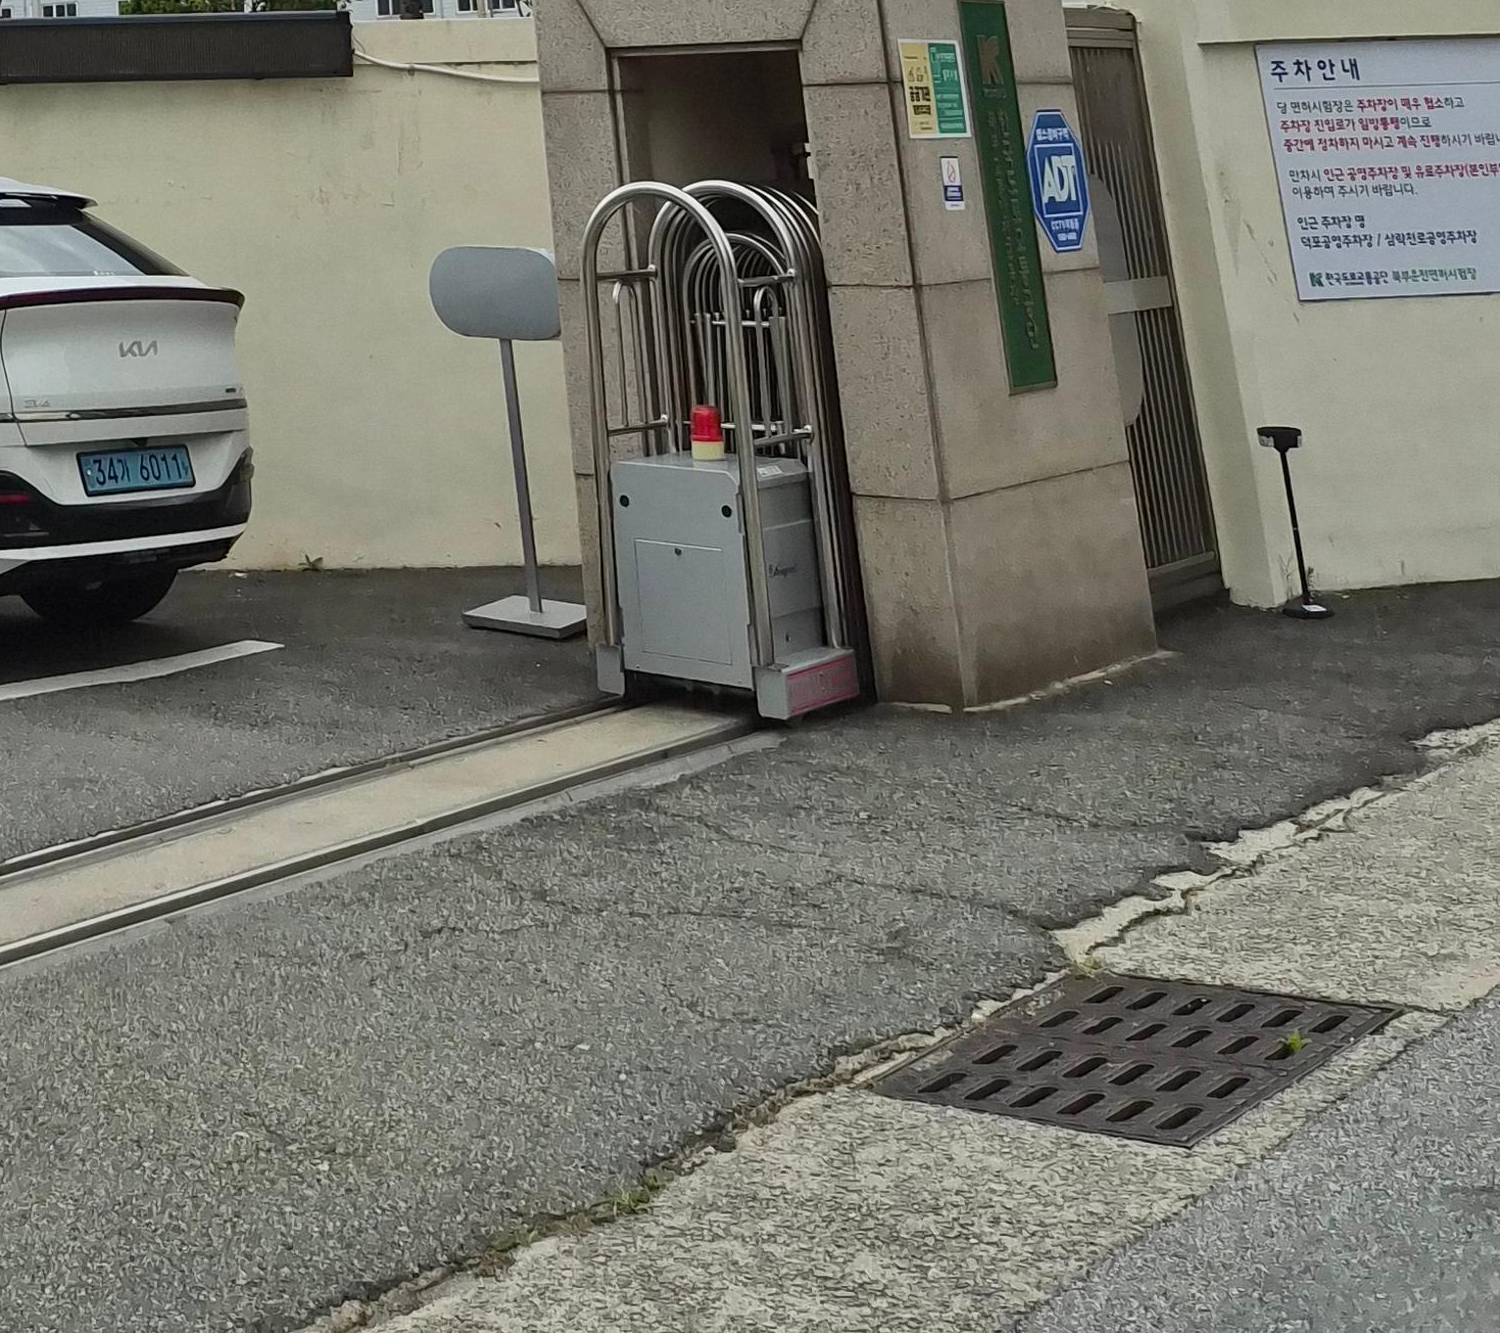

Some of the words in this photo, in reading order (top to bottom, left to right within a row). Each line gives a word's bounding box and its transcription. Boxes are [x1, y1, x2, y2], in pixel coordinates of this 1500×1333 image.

[1276, 102, 1287, 114] 당
[1290, 100, 1354, 114] 면허시험장은
[1357, 98, 1398, 112] 주차장이
[1400, 97, 1421, 110] 매우
[1424, 96, 1465, 110] 협소하고
[1280, 119, 1311, 133] 주차장
[1314, 118, 1356, 132] 진입로가
[1358, 116, 1432, 132] 일방통행이므로
[1283, 137, 1315, 152] 중간에
[1317, 136, 1360, 151] 정차하지
[1362, 135, 1395, 150] 마시고
[1420, 132, 1472, 148] 진행하시기
[1043, 155, 1077, 204] ADT
[1289, 168, 1321, 182] 만차시
[1324, 167, 1345, 181] 인근
[1347, 165, 1399, 181] 공영주차장
[1401, 165, 1412, 179] 및
[1292, 184, 1334, 199] 이용하여
[1338, 184, 1370, 198] 주시기
[1372, 182, 1418, 197] 바랍니다.
[1297, 216, 1319, 230] 인근
[1321, 215, 1352, 229] 주차장
[1354, 214, 1365, 228] 명
[1300, 234, 1373, 249] 덕포공영주차장
[140, 454, 182, 481] 6011
